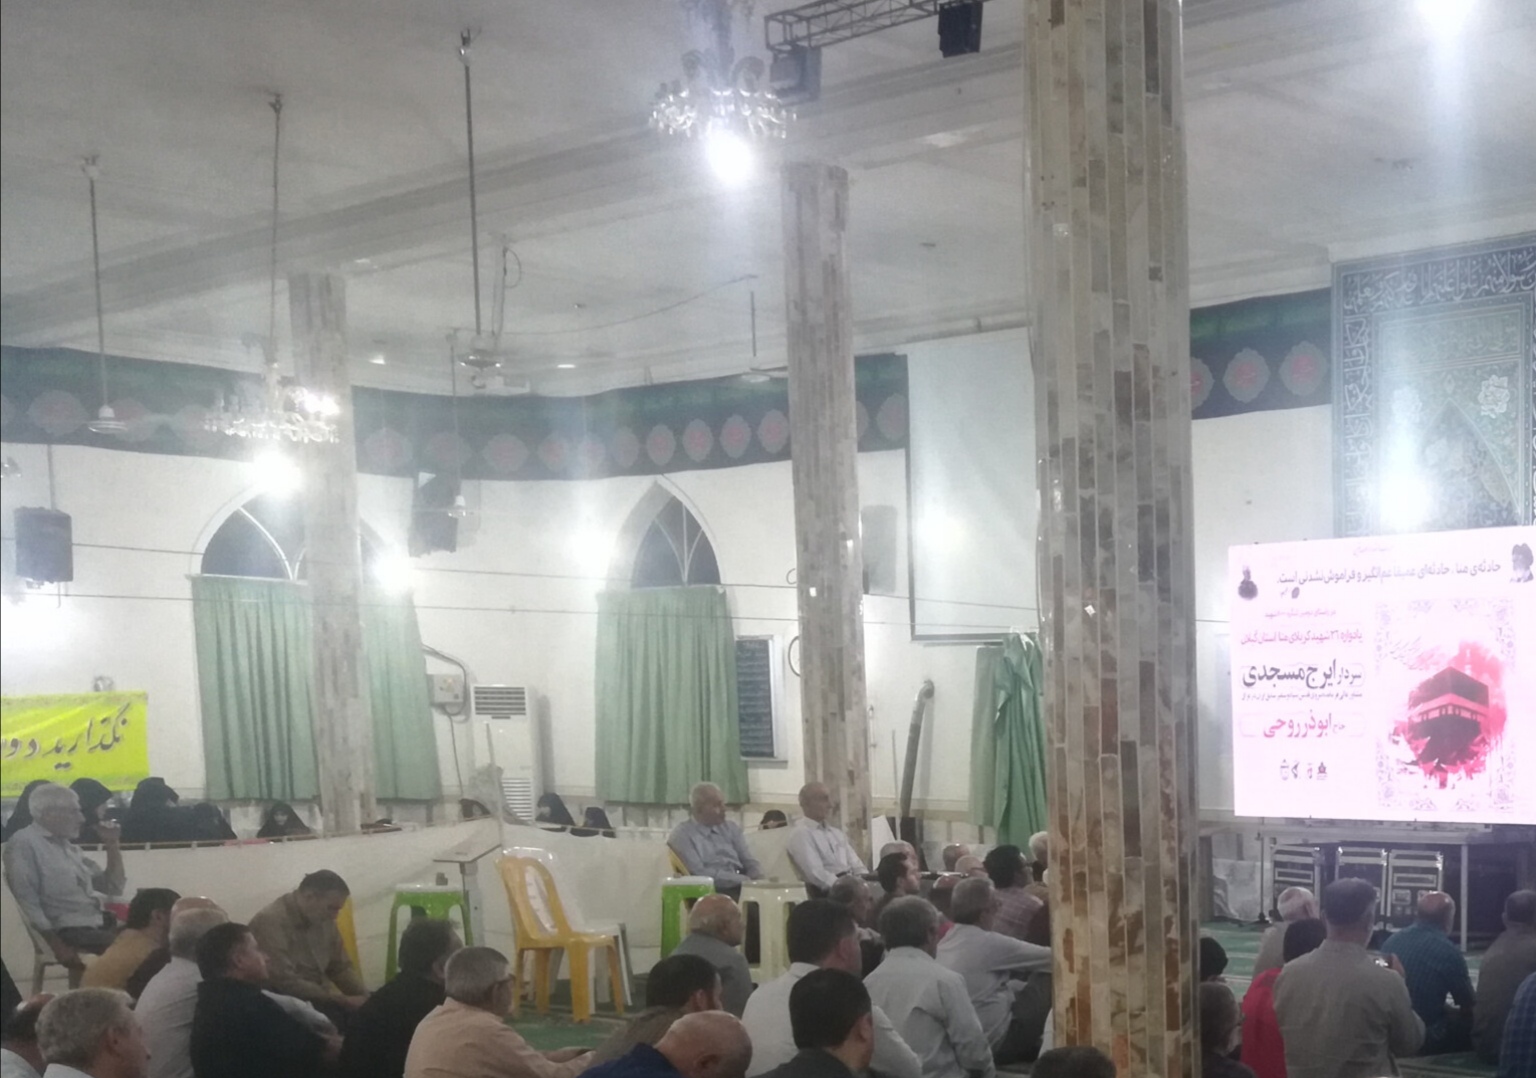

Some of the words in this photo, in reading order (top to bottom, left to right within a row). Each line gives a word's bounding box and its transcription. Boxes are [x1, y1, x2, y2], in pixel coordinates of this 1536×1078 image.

[1242, 664, 1306, 688] مسجدی
[1305, 657, 1337, 690] ایرج
[1337, 666, 1362, 686] سردار
